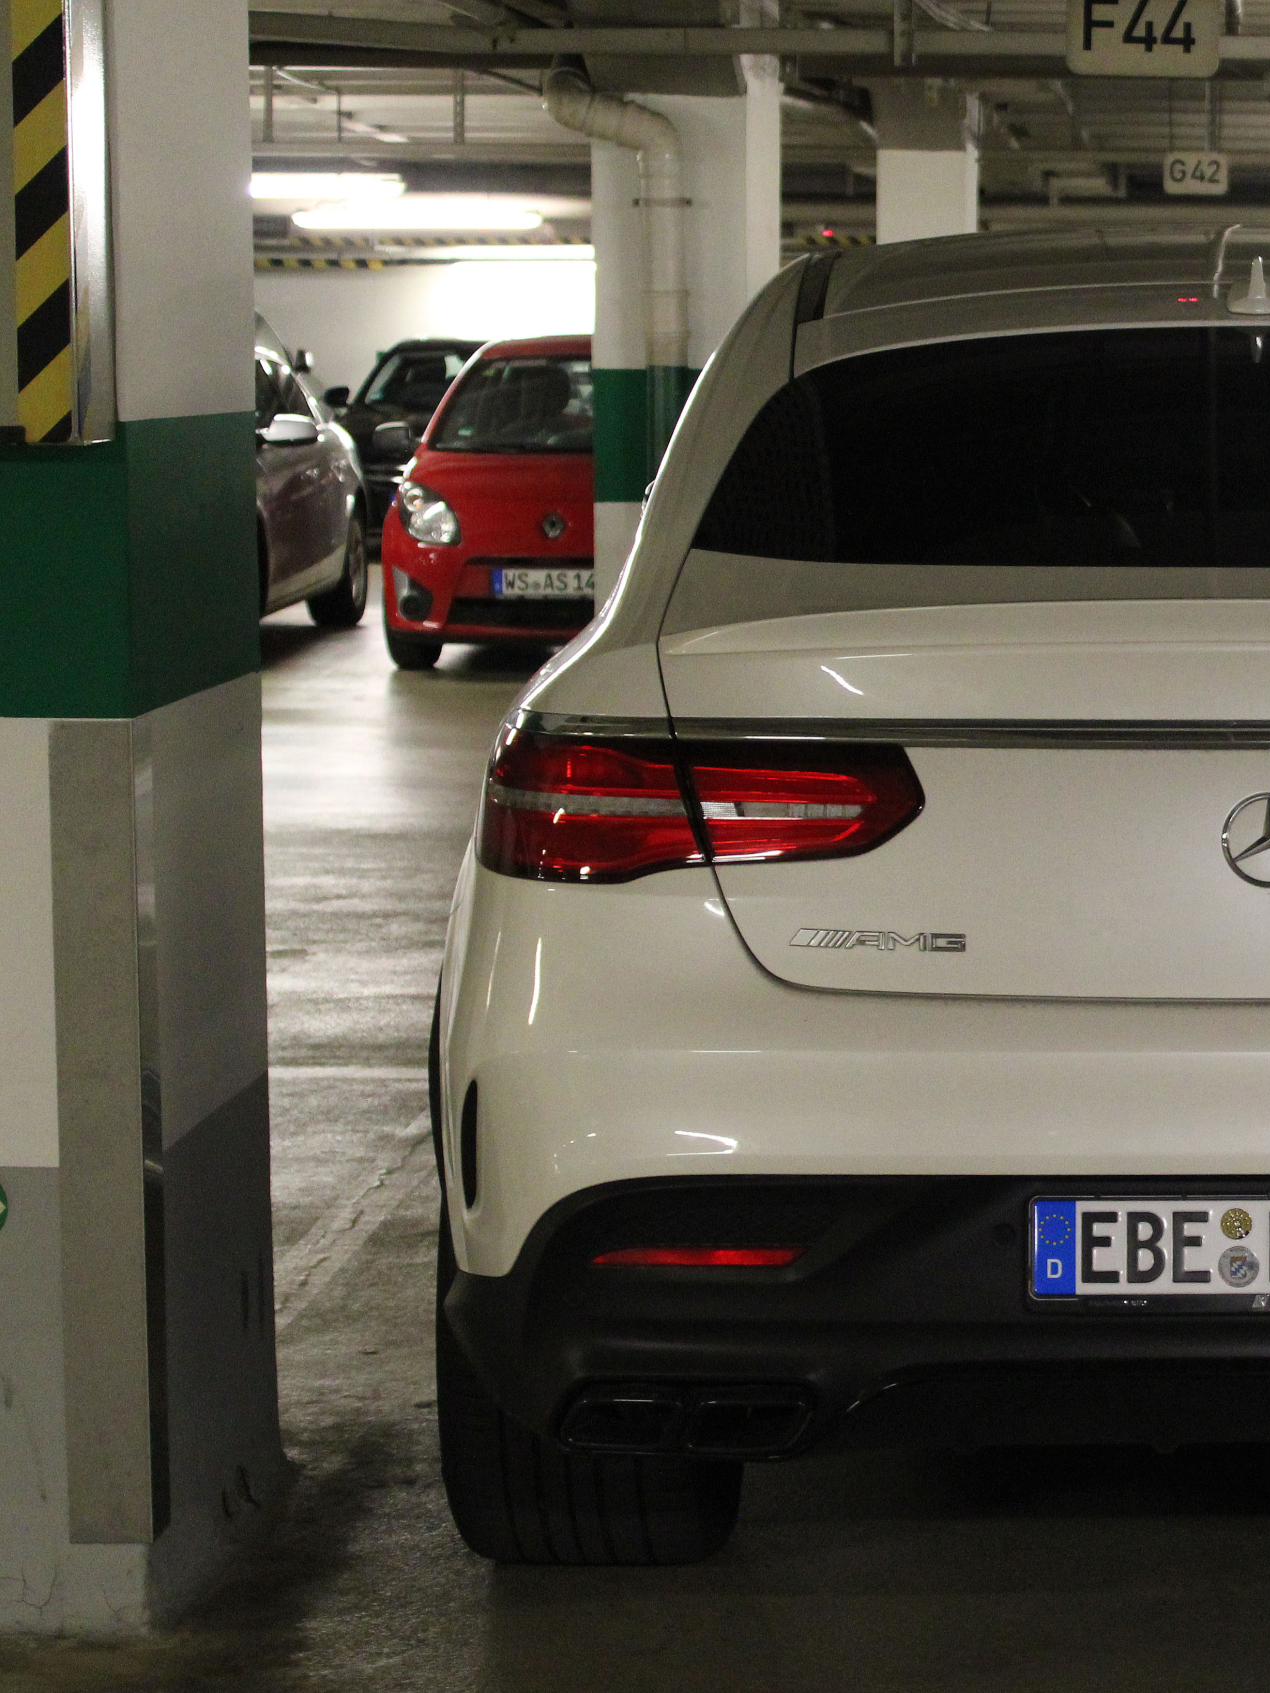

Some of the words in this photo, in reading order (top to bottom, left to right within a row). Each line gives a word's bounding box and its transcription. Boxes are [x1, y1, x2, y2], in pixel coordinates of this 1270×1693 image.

[1083, 0, 1196, 53] F44
[505, 572, 529, 591] WS
[544, 572, 568, 591] AS
[846, 930, 966, 952] AMG
[1081, 1211, 1212, 1284] EBE
[1046, 1258, 1063, 1279] D
